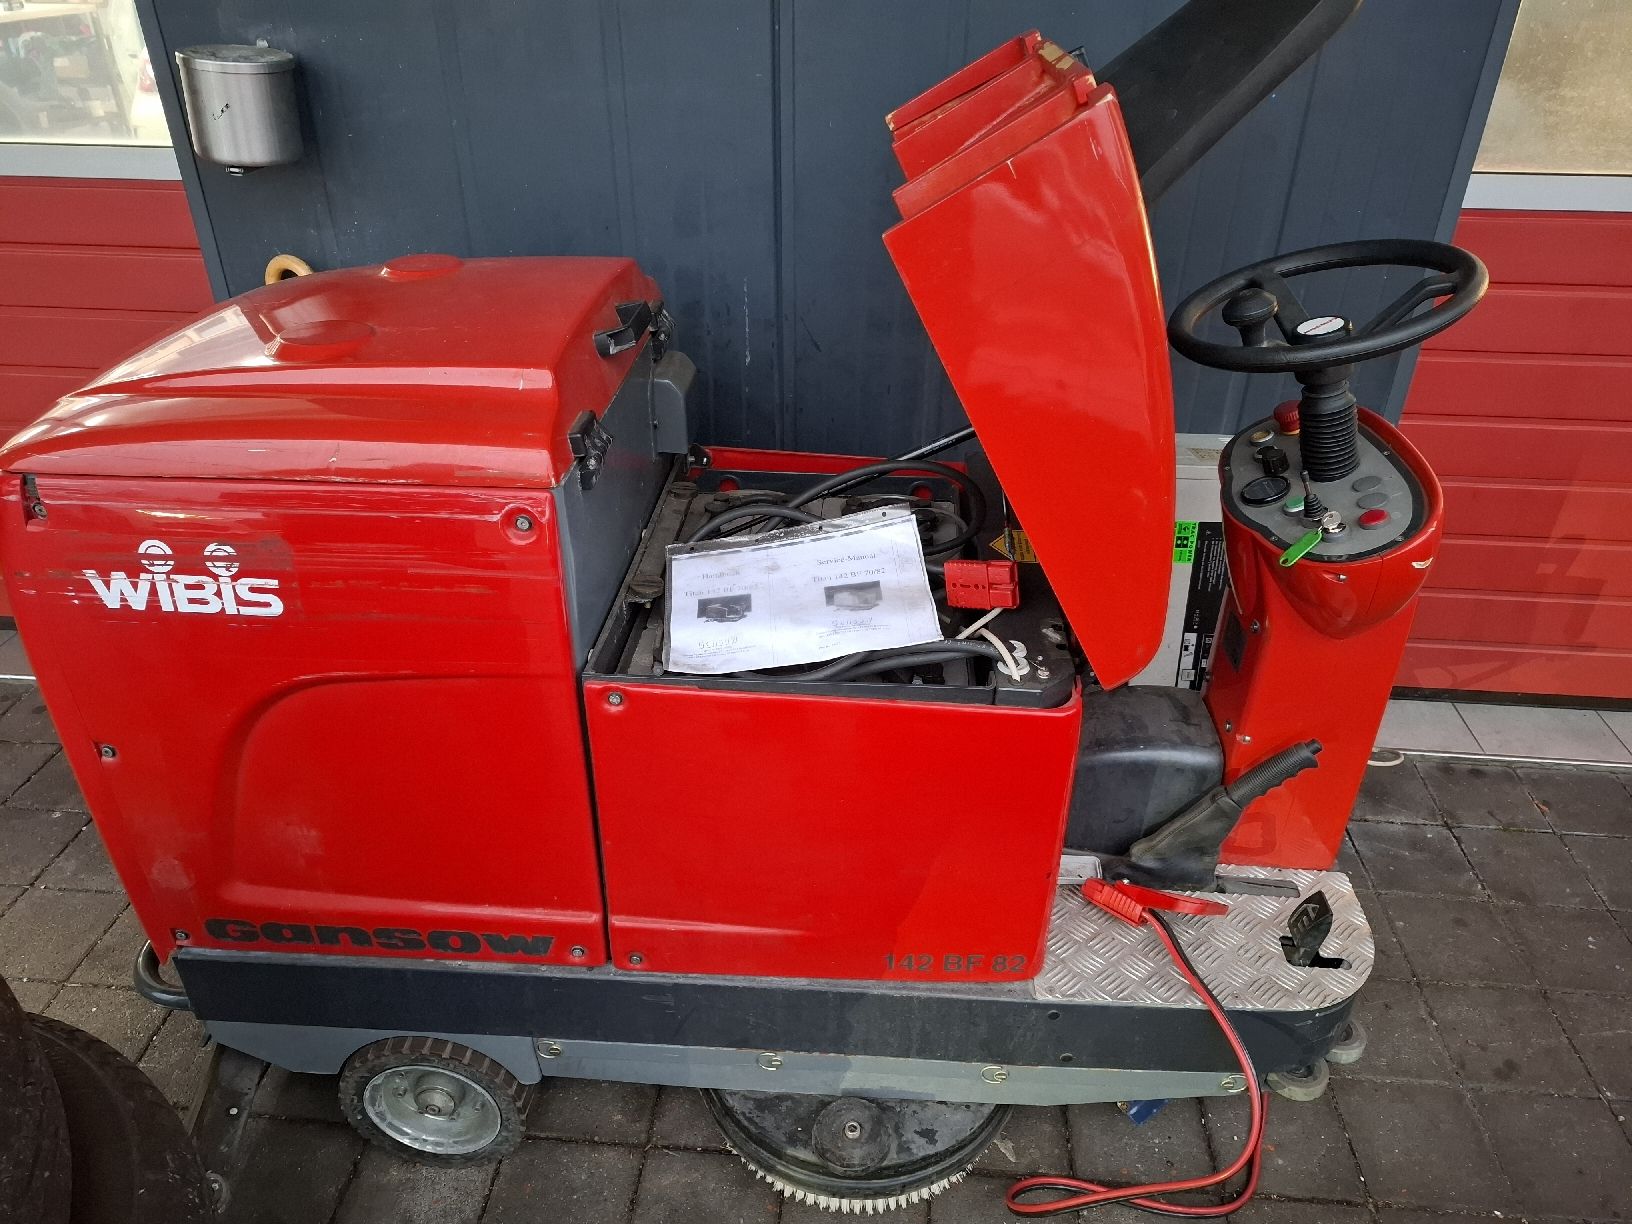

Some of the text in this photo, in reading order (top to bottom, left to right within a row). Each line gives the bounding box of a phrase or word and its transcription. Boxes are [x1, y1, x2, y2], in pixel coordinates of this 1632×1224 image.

[204, 919, 555, 956] Gansow
[884, 953, 1026, 973] 142 BF 82
